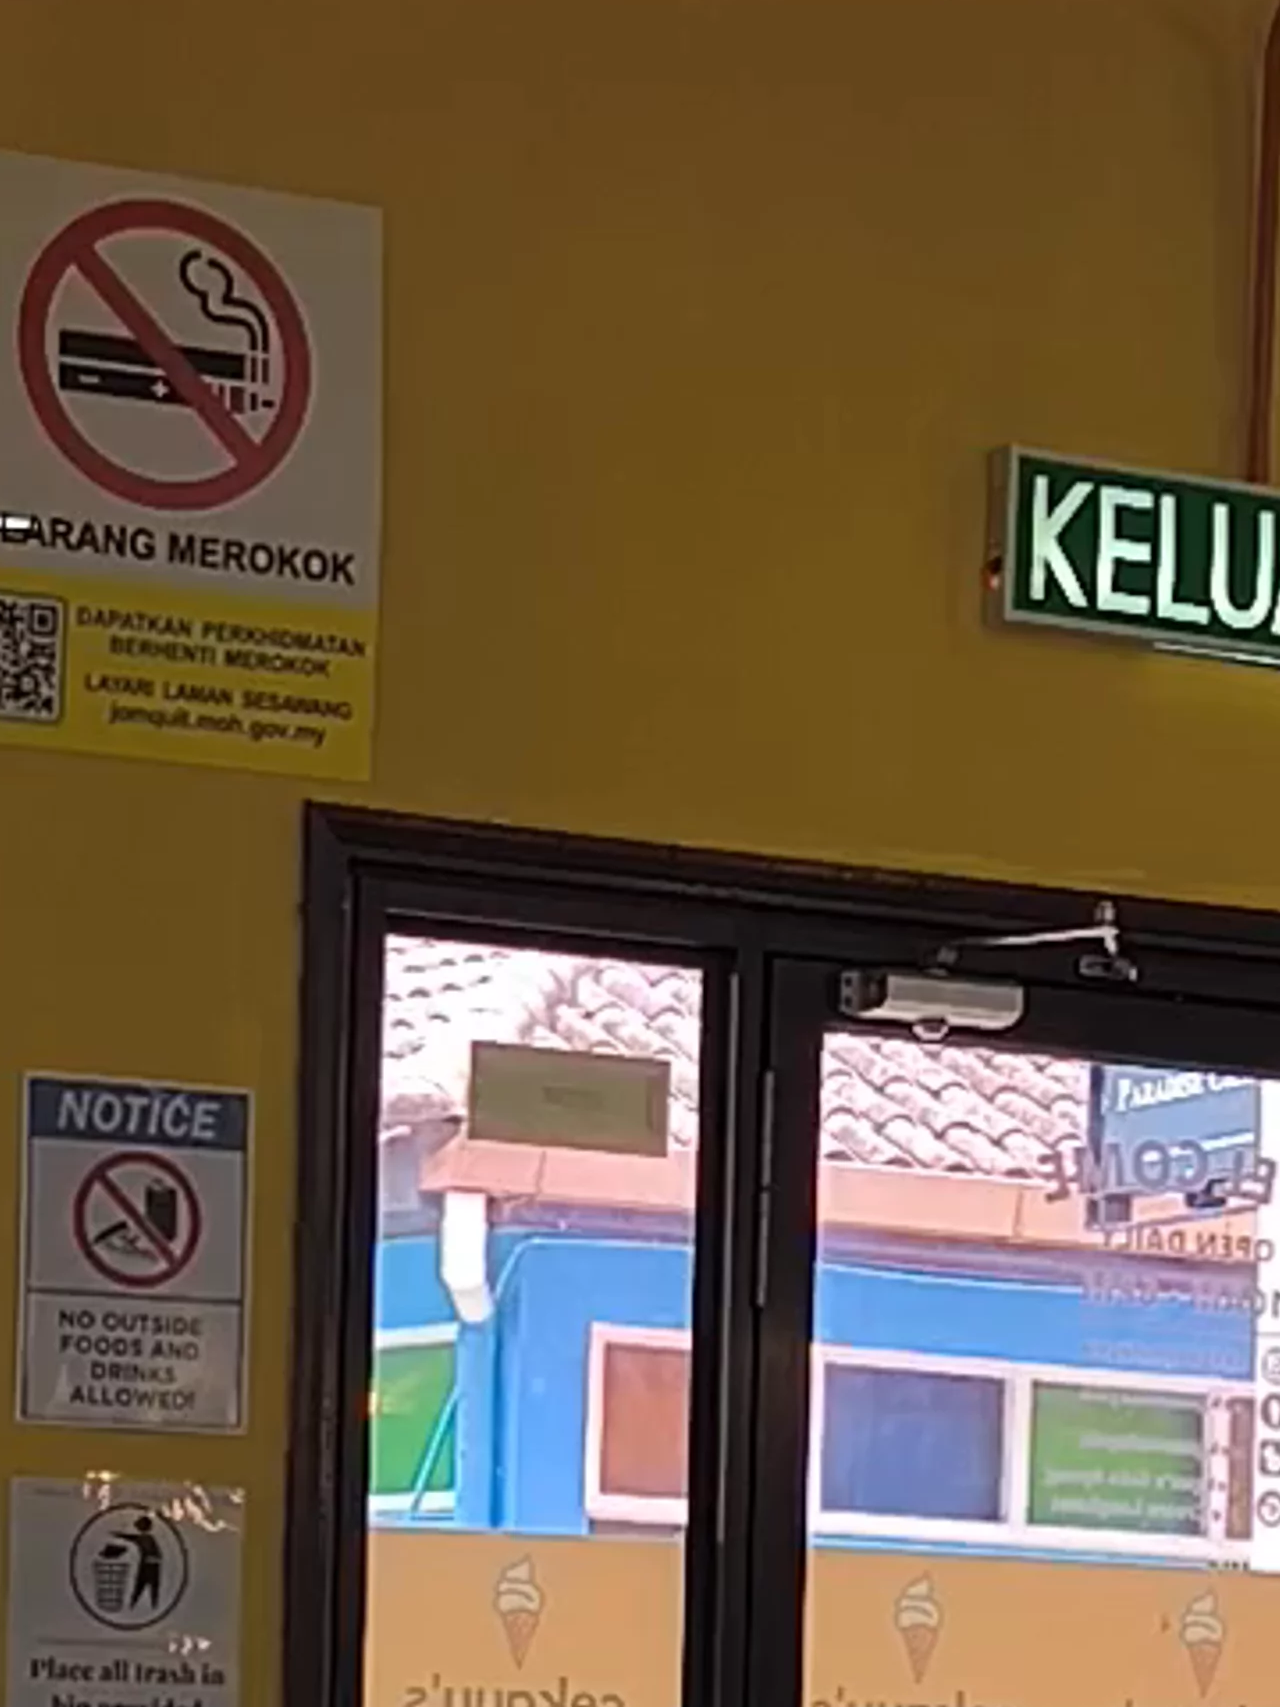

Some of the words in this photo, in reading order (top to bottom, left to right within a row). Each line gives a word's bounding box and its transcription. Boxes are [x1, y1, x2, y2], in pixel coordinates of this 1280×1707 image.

[168, 533, 356, 586] MEROKOK
[76, 606, 192, 638] DAPATKAN
[201, 621, 367, 657] PERKHIDMATAN
[109, 635, 217, 666] BERHENTI
[225, 649, 331, 678] MEROKOK
[84, 674, 155, 697] LAYARI
[163, 681, 234, 705] LAMAN
[241, 690, 352, 721] SESAWANG
[58, 1090, 221, 1141] NOTICE
[58, 1309, 95, 1330] NO
[102, 1312, 203, 1336] OUTSIDE
[59, 1334, 144, 1357] FOODS
[150, 1339, 199, 1361] AND
[90, 1362, 177, 1384] DRINKS
[30, 1657, 94, 1682] Place
[99, 1658, 129, 1682] all
[135, 1660, 196, 1685] trash
[201, 1661, 225, 1686] in
